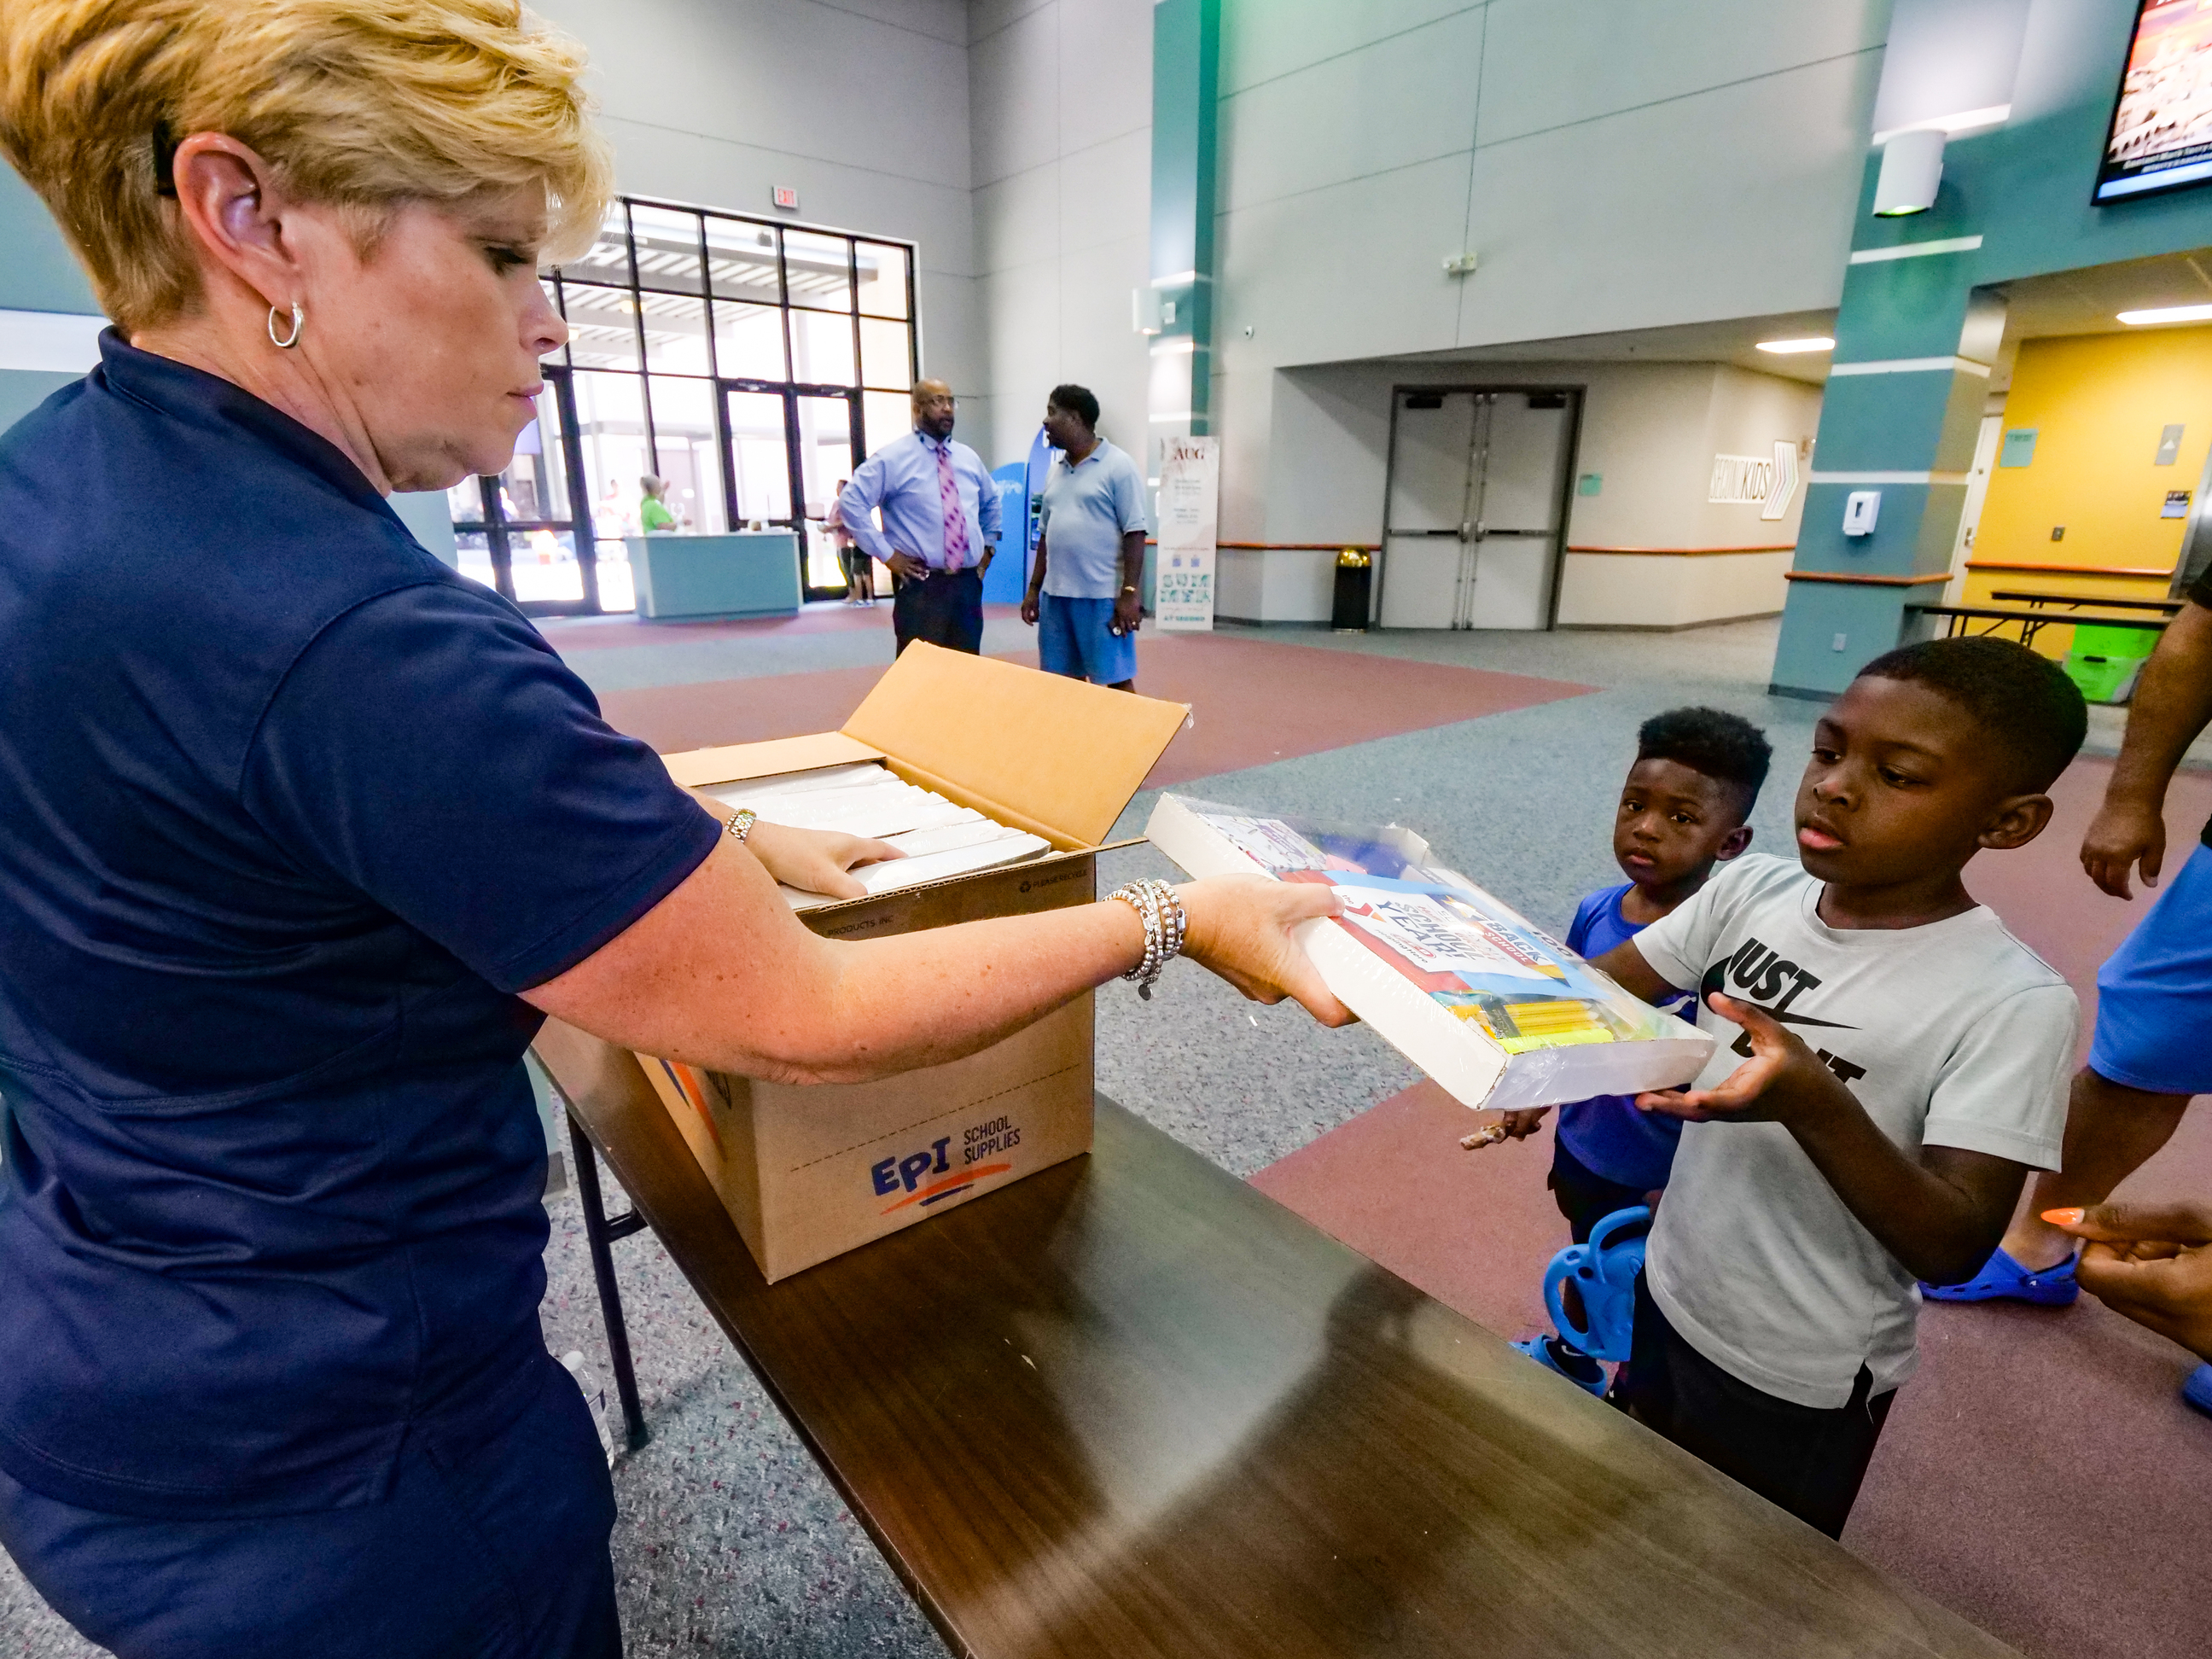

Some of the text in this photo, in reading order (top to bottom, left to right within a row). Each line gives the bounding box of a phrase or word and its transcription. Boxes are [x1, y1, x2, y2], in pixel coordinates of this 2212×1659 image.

[777, 188, 795, 204] EXIT
[828, 920, 876, 936] PRODUCTS
[1394, 902, 1485, 960] SCHOOL
[1487, 923, 1550, 962] BACK
[1485, 931, 1528, 963] SCHOOL
[963, 1115, 1012, 1145] SCHOOL
[964, 1128, 1021, 1165] SUPPLIES
[871, 1136, 951, 1196] EPI
